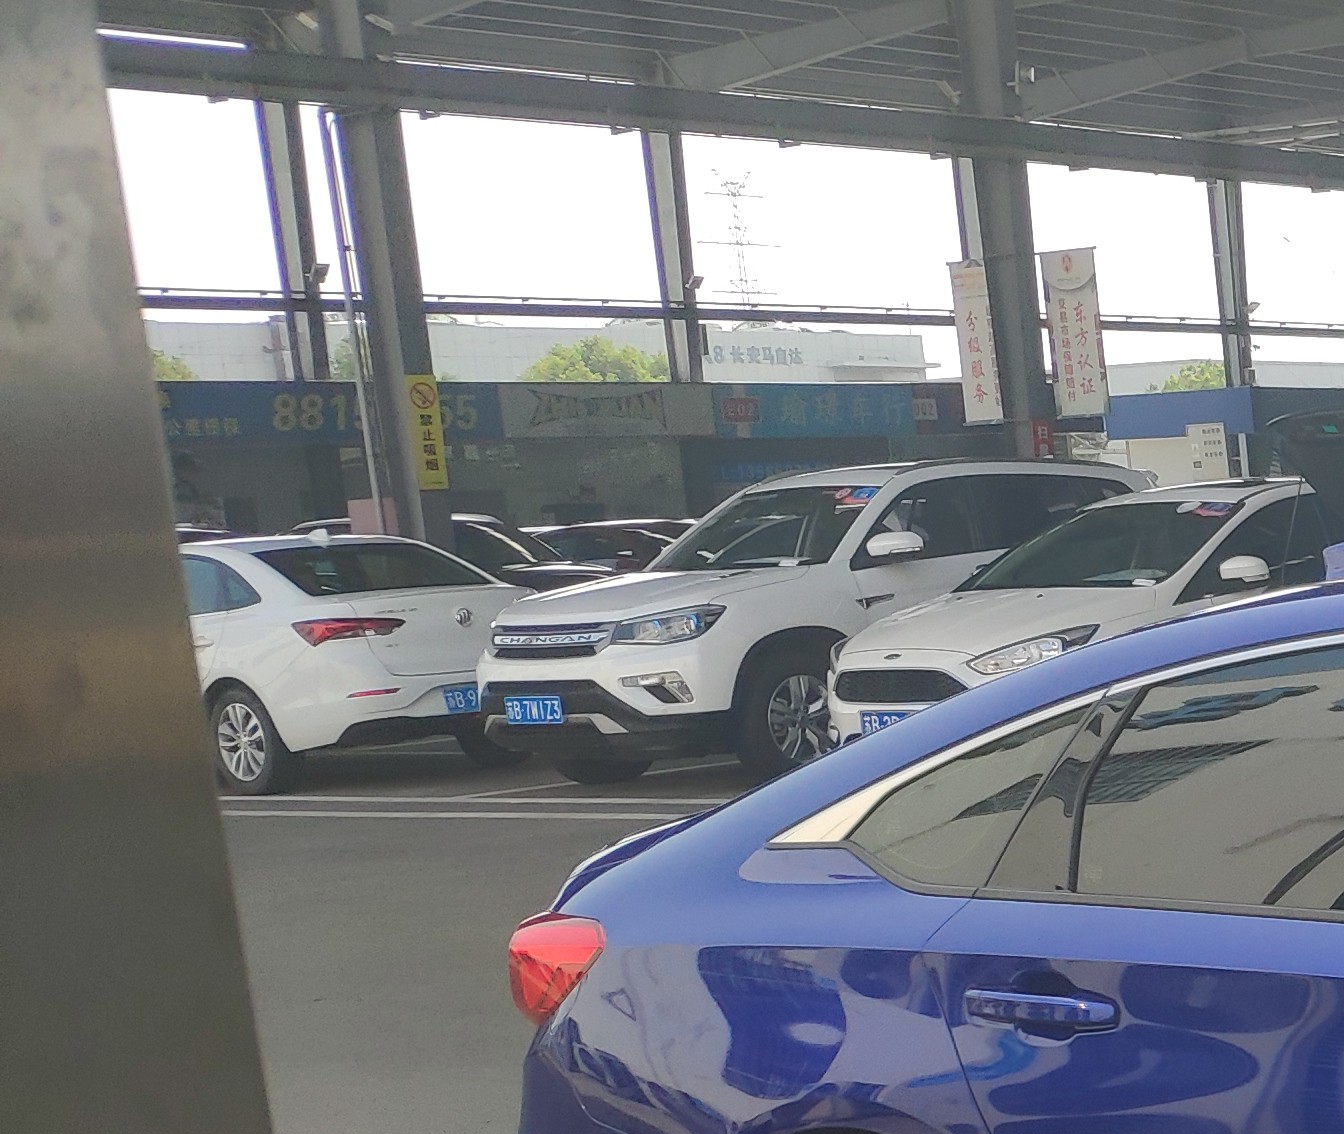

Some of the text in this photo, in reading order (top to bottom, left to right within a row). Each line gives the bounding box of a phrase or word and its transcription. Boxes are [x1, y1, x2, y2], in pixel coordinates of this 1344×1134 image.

[1074, 301, 1096, 394] 东方认证
[420, 414, 439, 471] 禁止吸烟
[500, 634, 592, 644] CHANGAN
